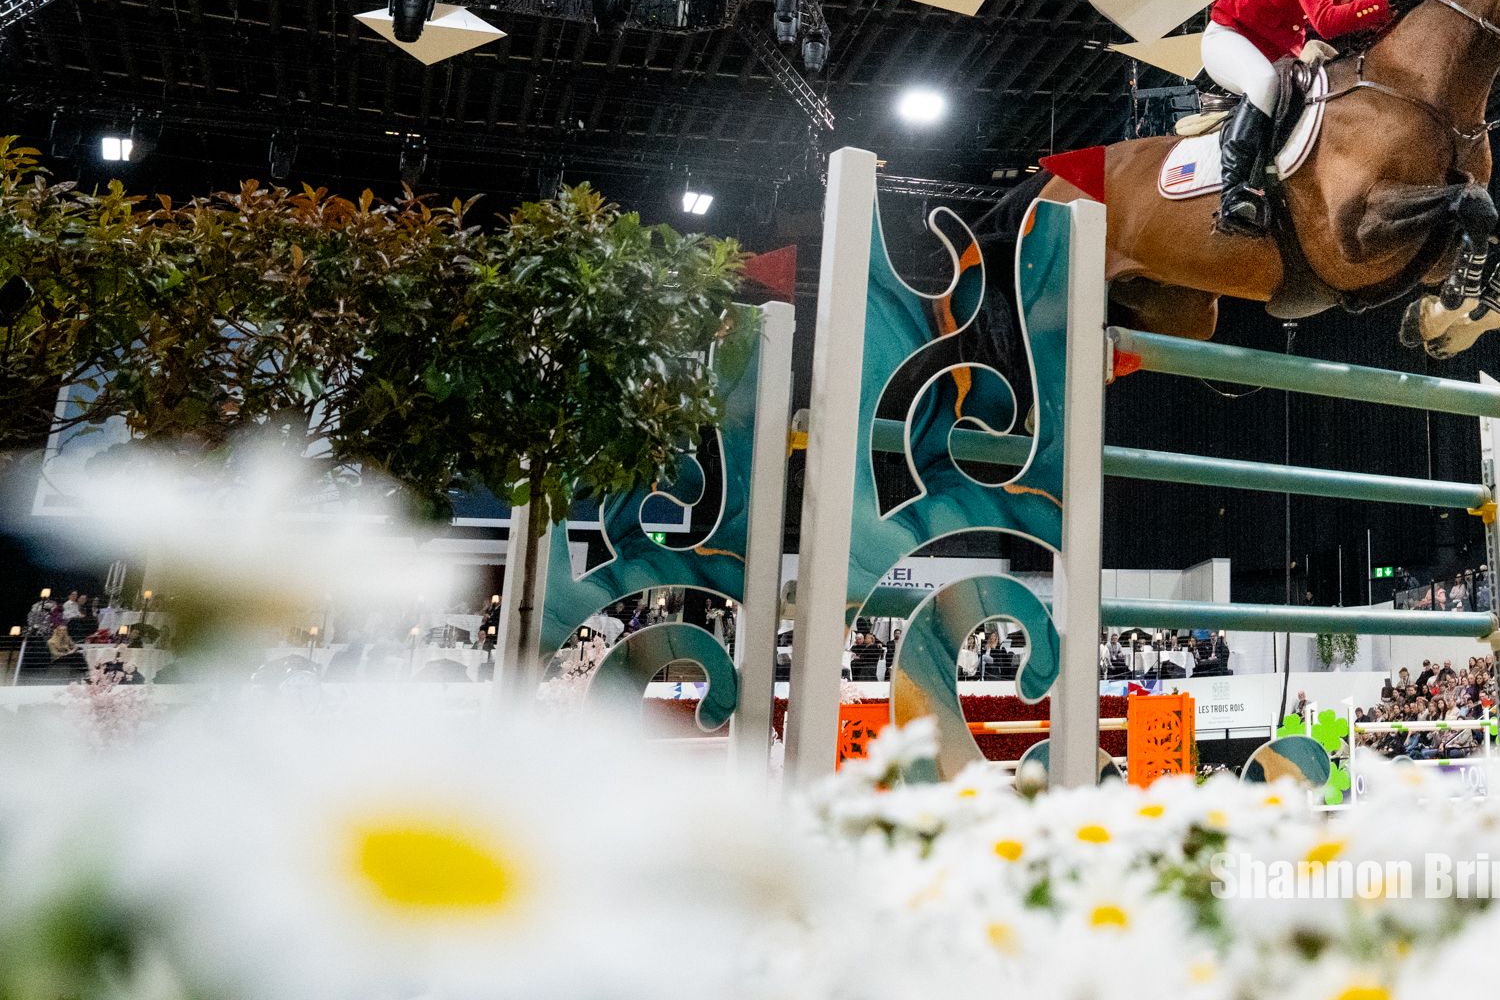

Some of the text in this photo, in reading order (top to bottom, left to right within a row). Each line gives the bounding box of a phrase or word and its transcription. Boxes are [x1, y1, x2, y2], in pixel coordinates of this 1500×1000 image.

[1198, 703, 1245, 714] LES TROIS ROIS
